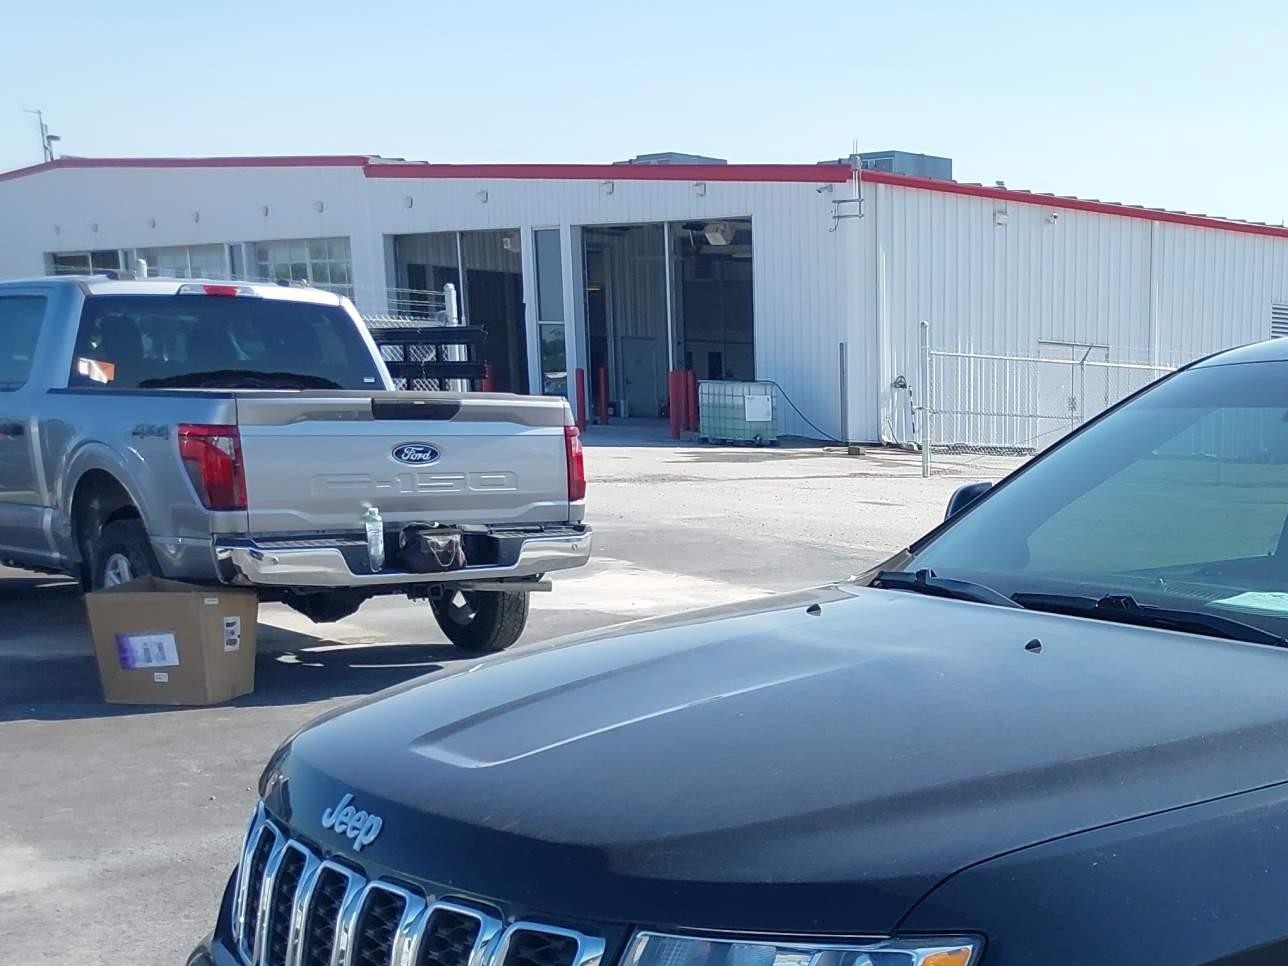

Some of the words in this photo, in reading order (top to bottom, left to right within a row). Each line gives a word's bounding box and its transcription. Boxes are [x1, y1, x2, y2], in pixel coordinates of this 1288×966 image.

[401, 446, 432, 460] Ford
[310, 471, 518, 495] F-150
[322, 793, 384, 852] Jeep
